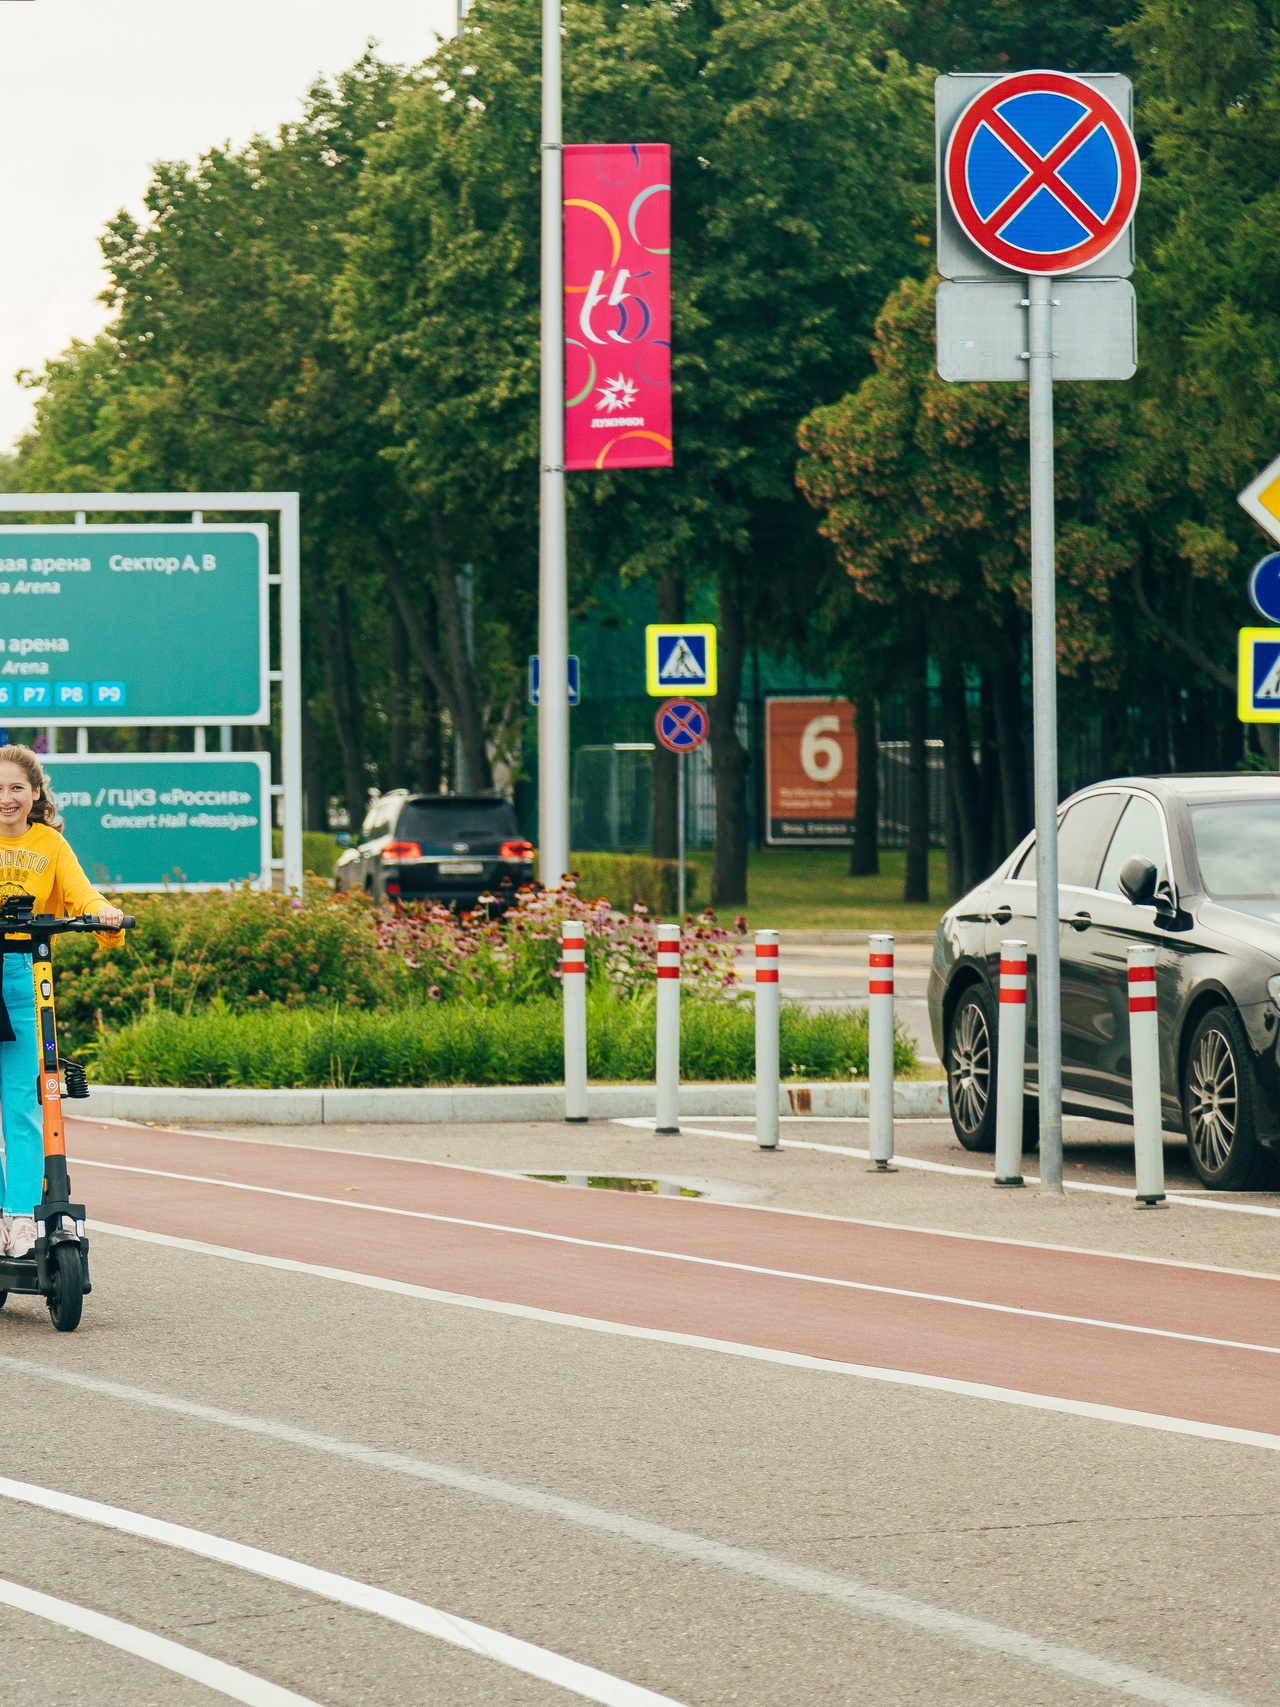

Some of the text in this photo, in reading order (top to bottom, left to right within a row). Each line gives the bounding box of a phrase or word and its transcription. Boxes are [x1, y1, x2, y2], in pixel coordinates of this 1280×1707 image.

[31, 558, 91, 575] арена
[109, 555, 180, 575] Сектор
[13, 580, 61, 594] Arena
[8, 638, 69, 656] арена
[2, 660, 49, 675] Arena
[24, 687, 45, 701] P7
[61, 687, 82, 702] P8
[99, 687, 120, 701] P9
[801, 716, 843, 782] 6
[159, 788, 251, 806] «Россия»
[101, 814, 157, 828] Concert
[157, 813, 187, 828] Hall
